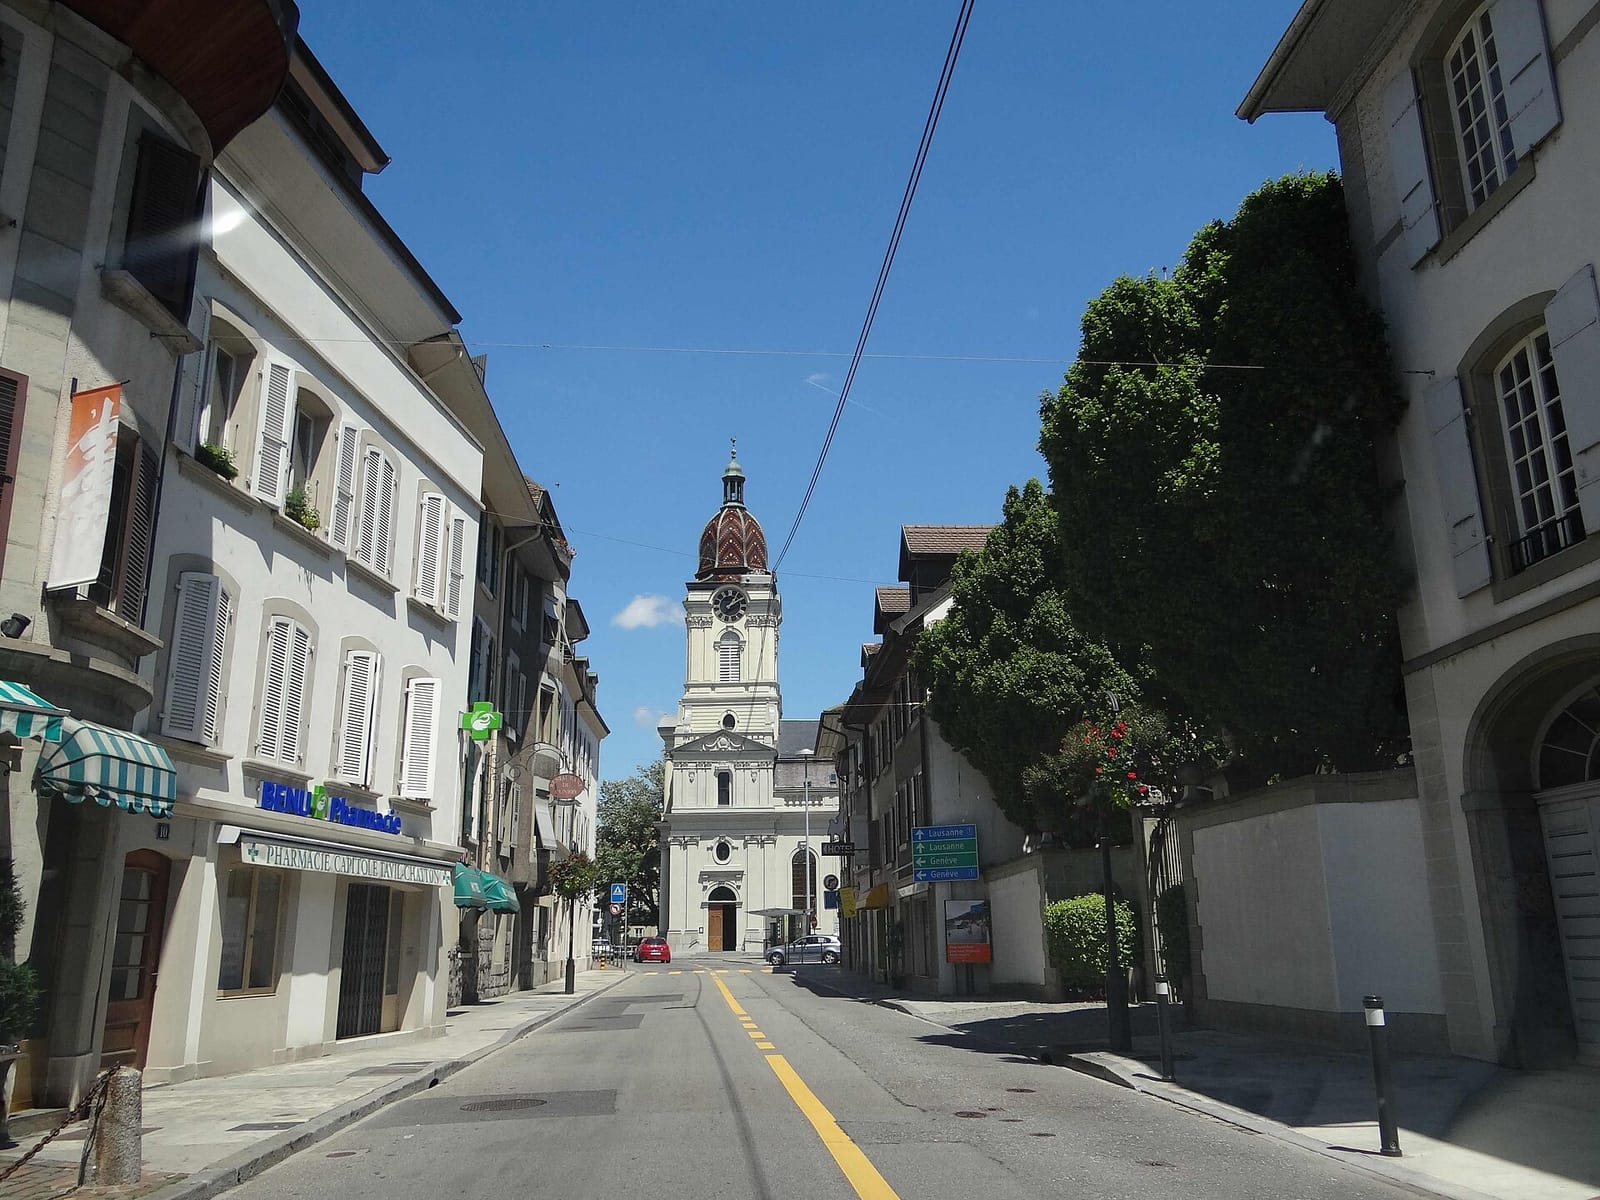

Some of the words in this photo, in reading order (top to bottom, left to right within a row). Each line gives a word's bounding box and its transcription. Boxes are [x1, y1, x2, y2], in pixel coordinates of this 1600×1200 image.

[260, 781, 312, 817] BENU
[329, 797, 402, 835] Pharmacie
[929, 829, 963, 838] Lausanne
[930, 843, 965, 851] Lausanne
[266, 846, 331, 872] PHARMACIE
[334, 855, 378, 877] CAPITOLE
[930, 856, 958, 865] Genève
[930, 870, 959, 879] Genève
